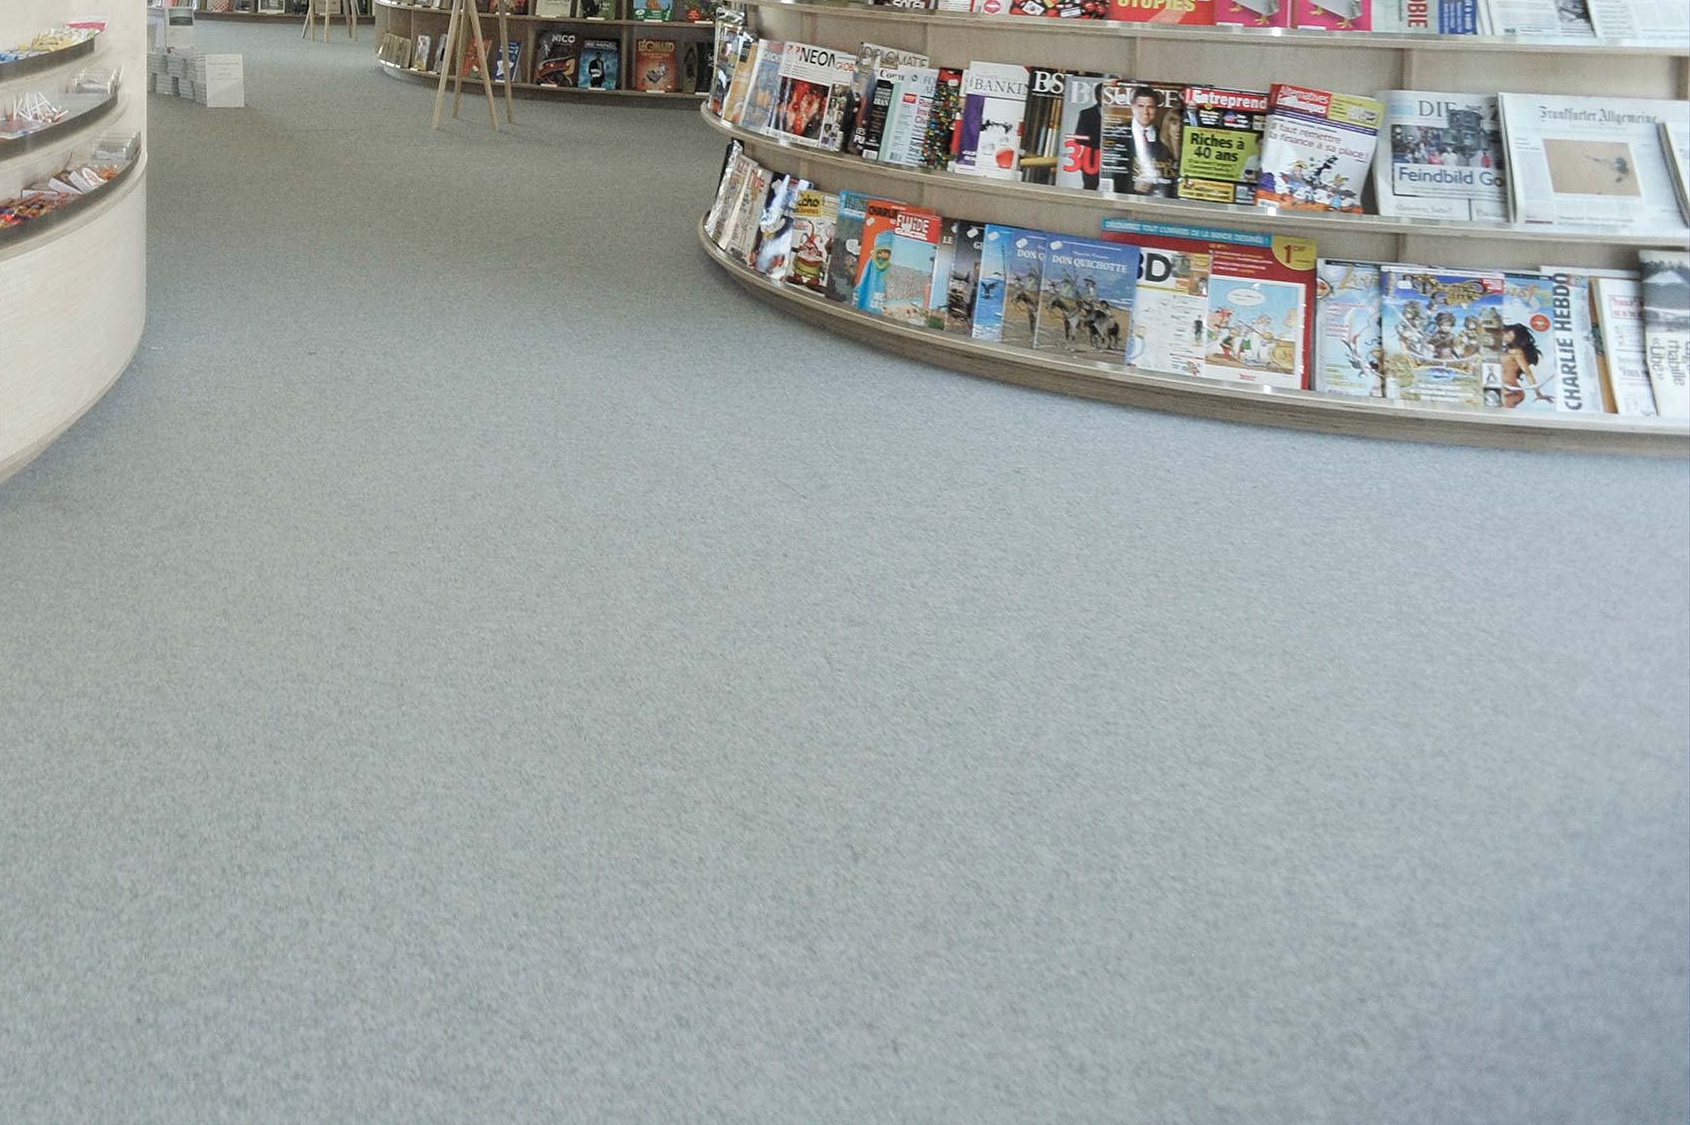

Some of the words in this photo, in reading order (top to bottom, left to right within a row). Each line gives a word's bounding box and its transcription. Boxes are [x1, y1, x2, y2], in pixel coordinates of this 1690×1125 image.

[552, 34, 576, 44] NICO
[1540, 105, 1596, 123] Frankfurter
[1599, 108, 1658, 126] Allgemeine
[1190, 132, 1233, 150] Riches
[1236, 133, 1245, 150] à
[1279, 122, 1298, 135] faut
[1299, 127, 1342, 144] remettre
[1279, 132, 1315, 149] finance
[1194, 146, 1211, 159] 40
[1215, 150, 1239, 162] ans
[1399, 170, 1473, 185] Feindbild
[942, 236, 953, 245] LE
[1016, 248, 1037, 259] DON
[1284, 244, 1292, 264] 1
[1052, 253, 1072, 265] DON
[1073, 256, 1128, 273] QUICHOTTE
[1552, 273, 1574, 333] HEBDO
[1555, 336, 1582, 411] CHARLIE
